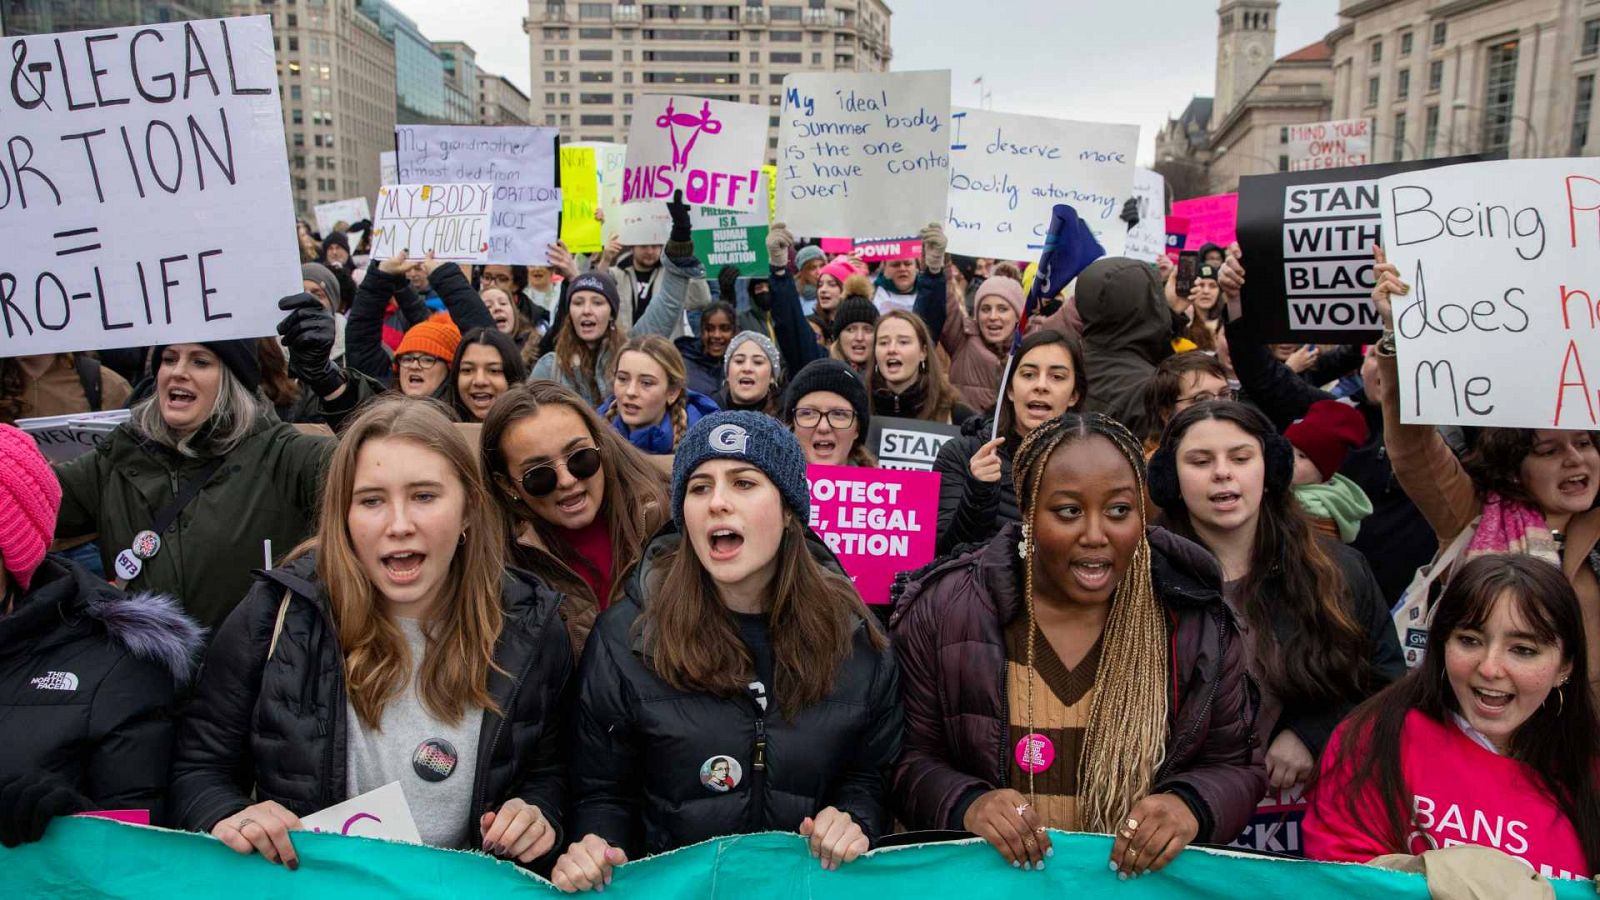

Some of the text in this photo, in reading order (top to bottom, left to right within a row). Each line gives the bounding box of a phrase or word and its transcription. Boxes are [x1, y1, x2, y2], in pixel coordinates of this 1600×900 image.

[54, 20, 272, 111] LEGAL
[784, 88, 888, 117] My ideal
[885, 108, 942, 132] body
[1290, 121, 1367, 140] MIND YOUR
[397, 128, 531, 165] My grandmother
[812, 142, 850, 157] the
[863, 142, 904, 156] one
[951, 113, 1126, 164] I deserve more
[1309, 141, 1346, 157] OWN
[401, 160, 448, 179] almost
[486, 163, 520, 180] from
[784, 164, 801, 180] I
[813, 163, 863, 179] have
[493, 186, 558, 201] ORTION
[622, 165, 675, 205] BANS
[686, 169, 759, 206] OFF!
[951, 168, 1116, 218] bodily autonomy
[382, 188, 420, 219] MY
[1289, 185, 1378, 214] STAN
[719, 216, 737, 227] IS A
[1392, 175, 1600, 260] Being P
[373, 220, 418, 259] MY
[713, 228, 747, 241] HUMAN
[714, 240, 749, 253] RIGHTS
[1289, 225, 1381, 252] WITH
[707, 251, 757, 265] VIOLATION
[855, 244, 901, 257] DOWN
[1398, 258, 1600, 339] does n
[1554, 340, 1600, 426] A
[709, 424, 747, 454] G
[807, 479, 902, 505] OTECT
[837, 506, 921, 532] LEGAL
[119, 553, 138, 575] 1973
[31, 677, 64, 685] NORTH
[47, 671, 66, 679] THE
[1411, 795, 1529, 854] BANS
